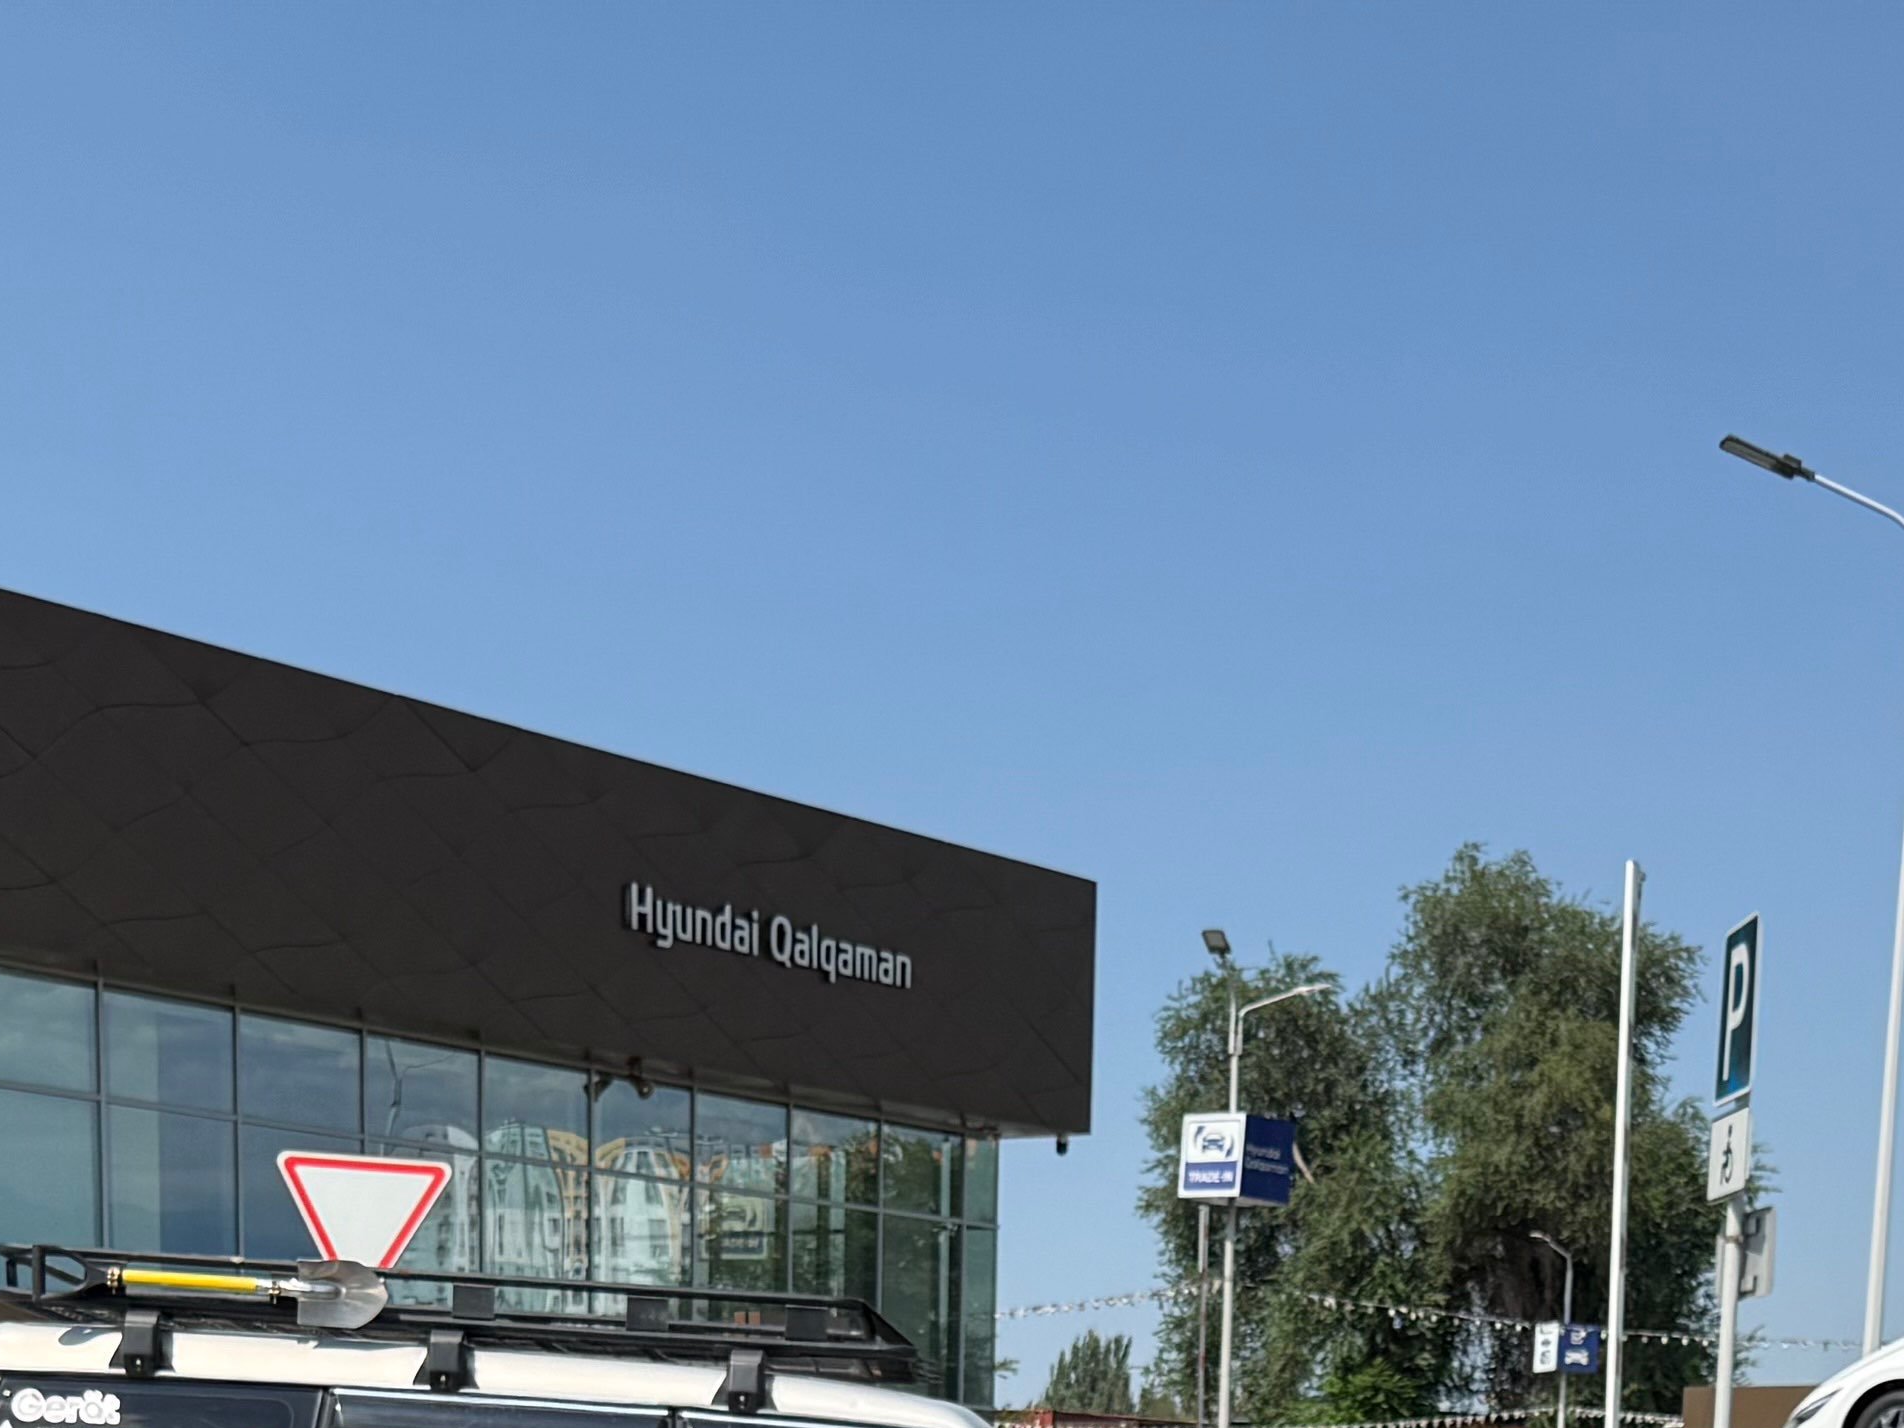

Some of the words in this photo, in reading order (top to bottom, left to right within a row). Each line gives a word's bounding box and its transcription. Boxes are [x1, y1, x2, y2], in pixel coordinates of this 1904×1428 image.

[628, 881, 760, 957] Hyundai
[769, 914, 913, 989] Qalqaman
[1722, 942, 1750, 1082] P
[11, 1387, 121, 1426] Gerät
